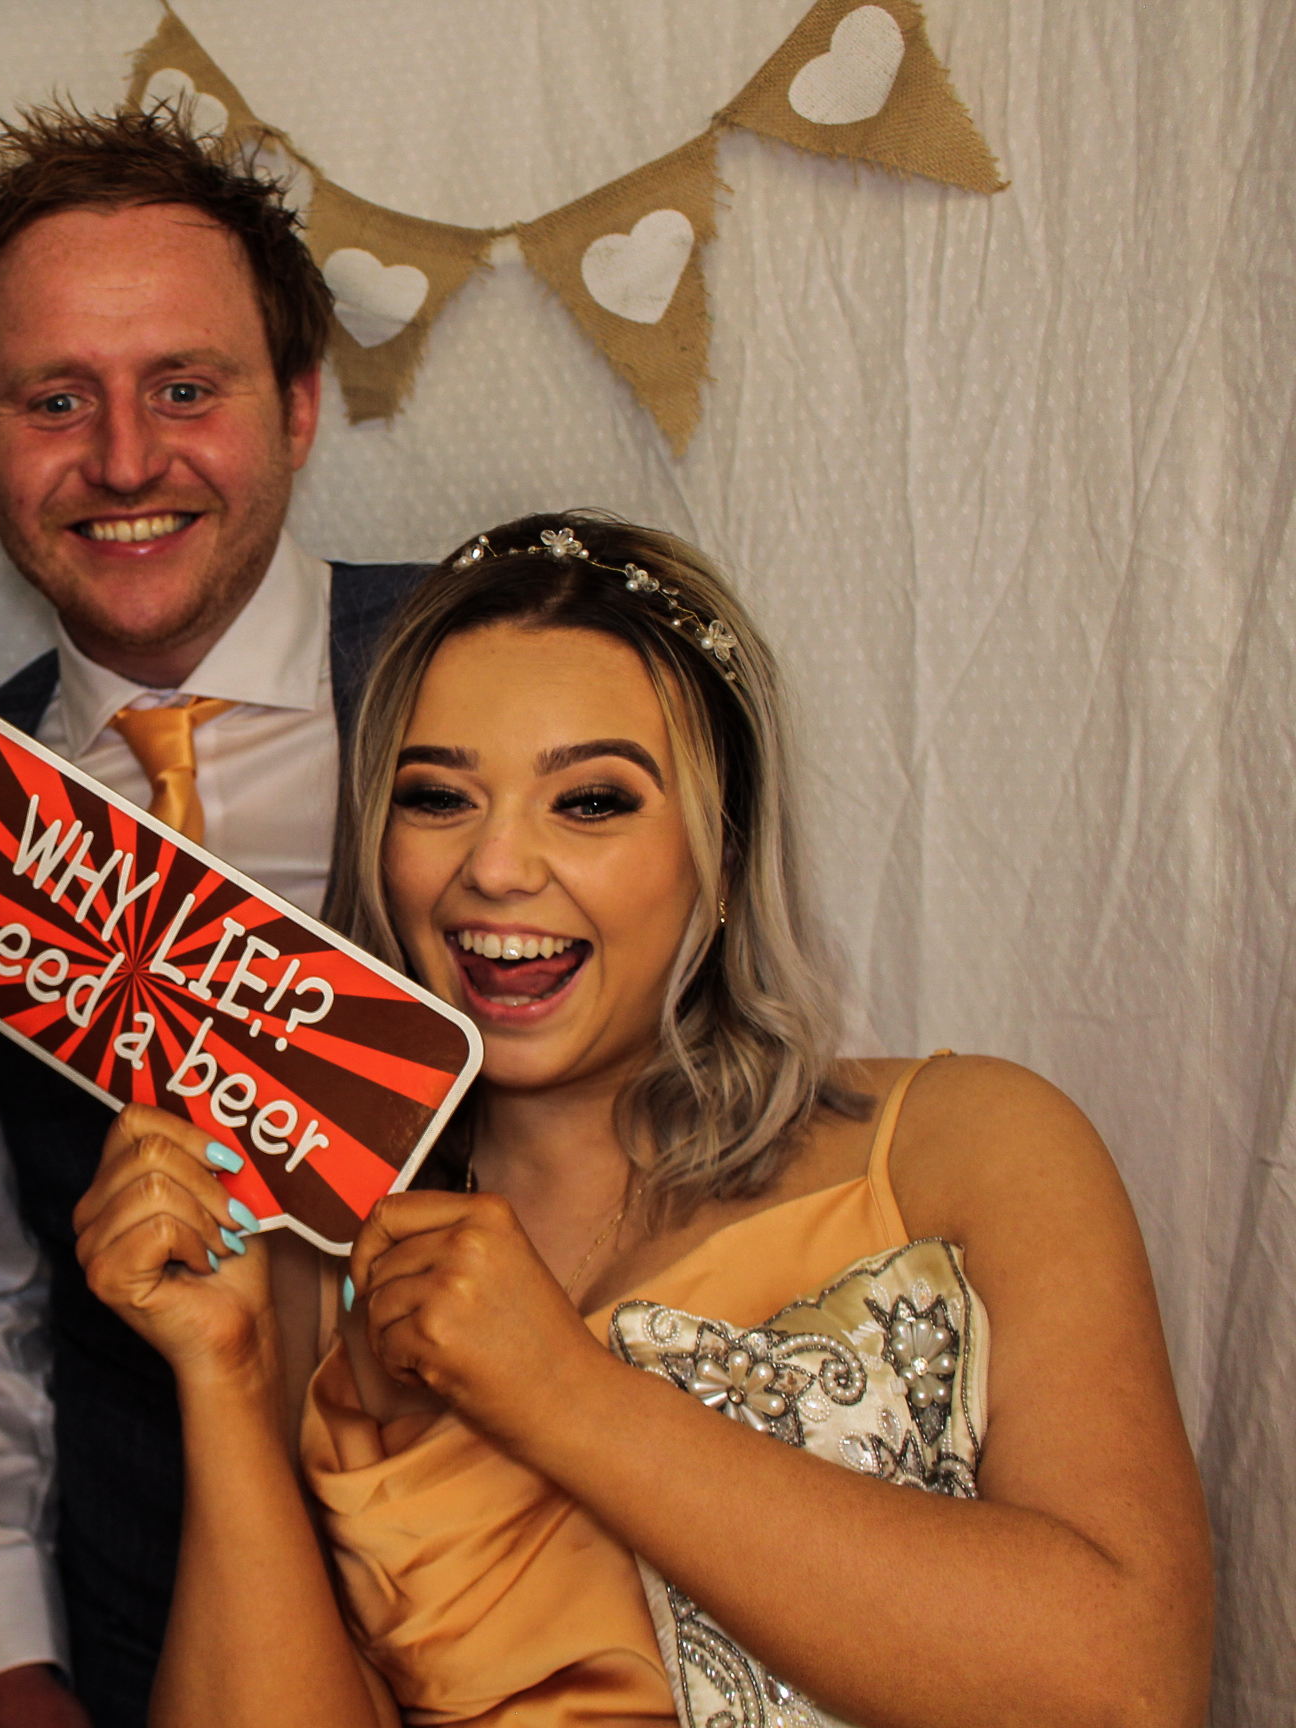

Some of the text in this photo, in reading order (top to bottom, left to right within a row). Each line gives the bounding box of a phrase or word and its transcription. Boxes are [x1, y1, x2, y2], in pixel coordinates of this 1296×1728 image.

[13, 794, 334, 1051] WHY LIE!?
[113, 1012, 156, 1071] a
[165, 1017, 329, 1172] beer
